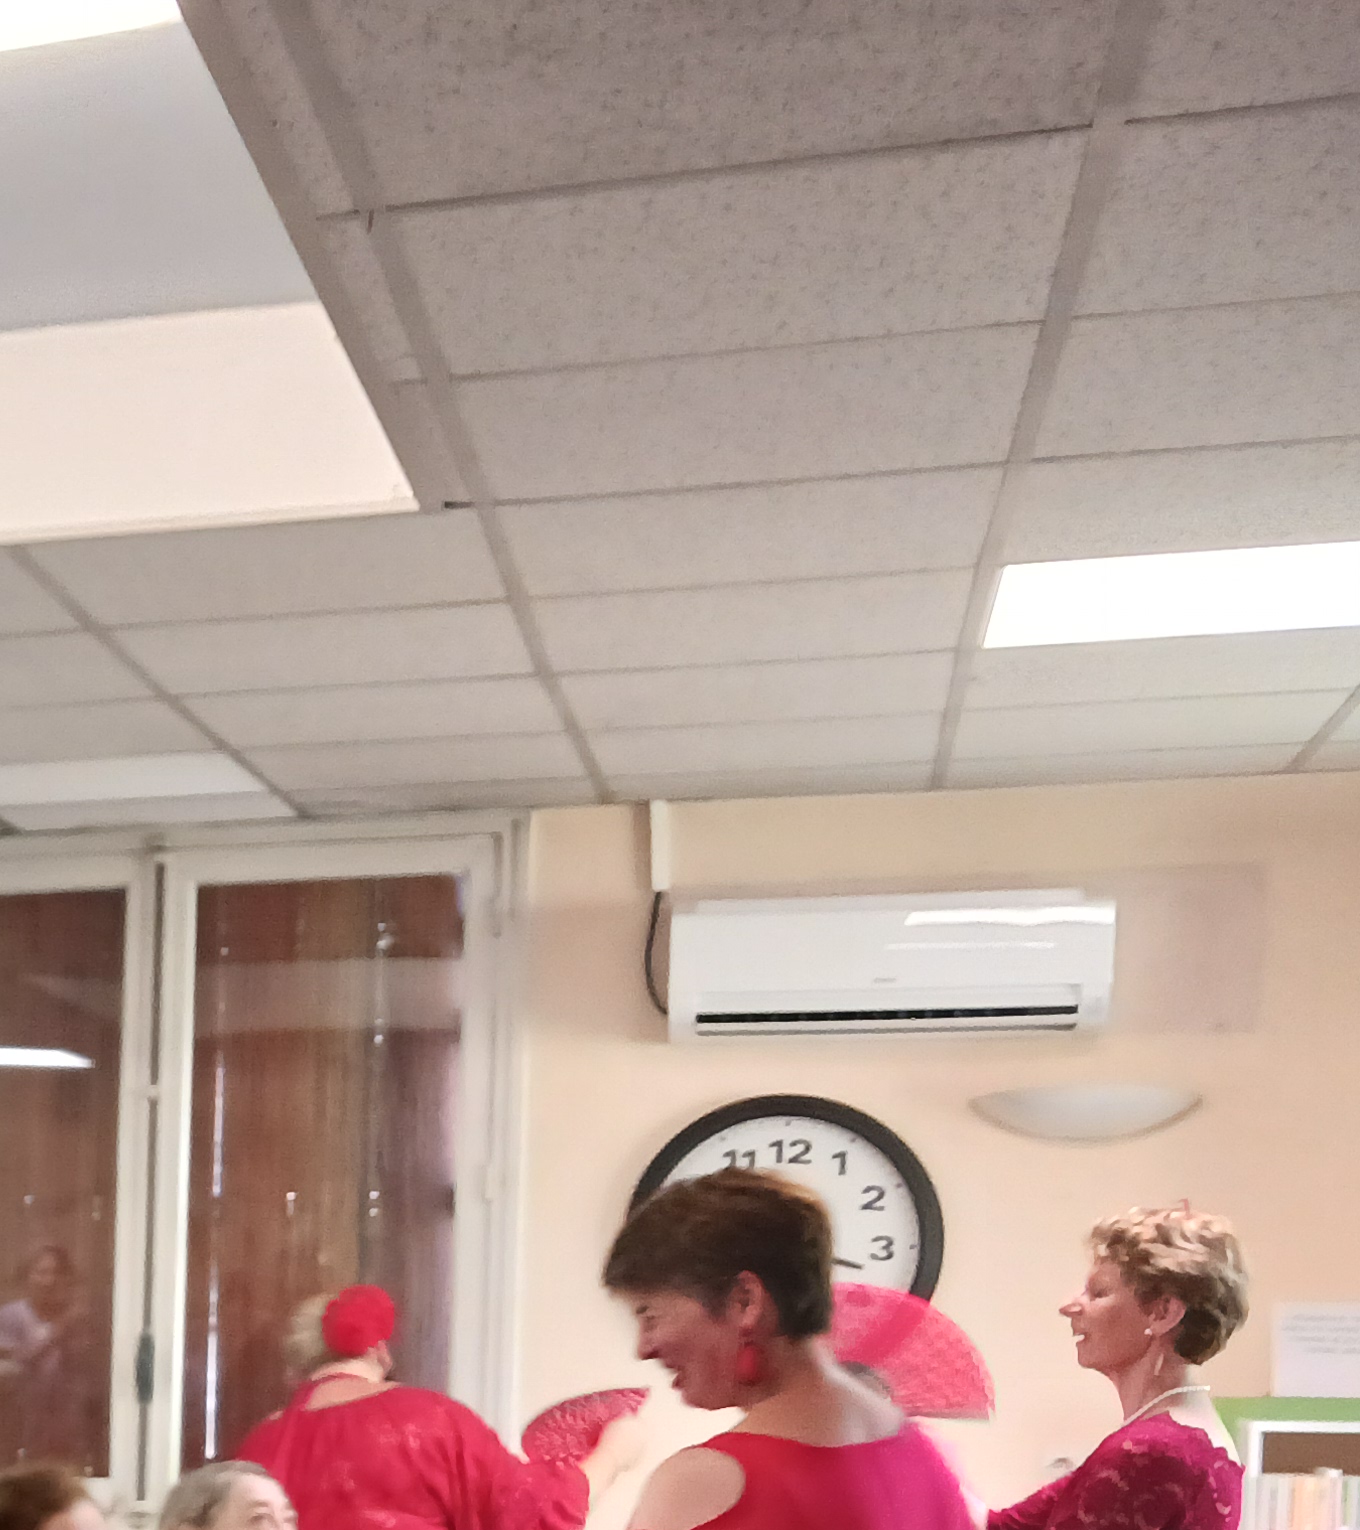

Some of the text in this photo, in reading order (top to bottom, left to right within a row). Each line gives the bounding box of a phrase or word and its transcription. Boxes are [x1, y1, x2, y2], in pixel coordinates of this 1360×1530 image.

[722, 1149, 756, 1169] 11
[768, 1138, 813, 1165] 12
[831, 1150, 848, 1176] 1
[860, 1184, 886, 1211] 2
[870, 1235, 894, 1261] 3
